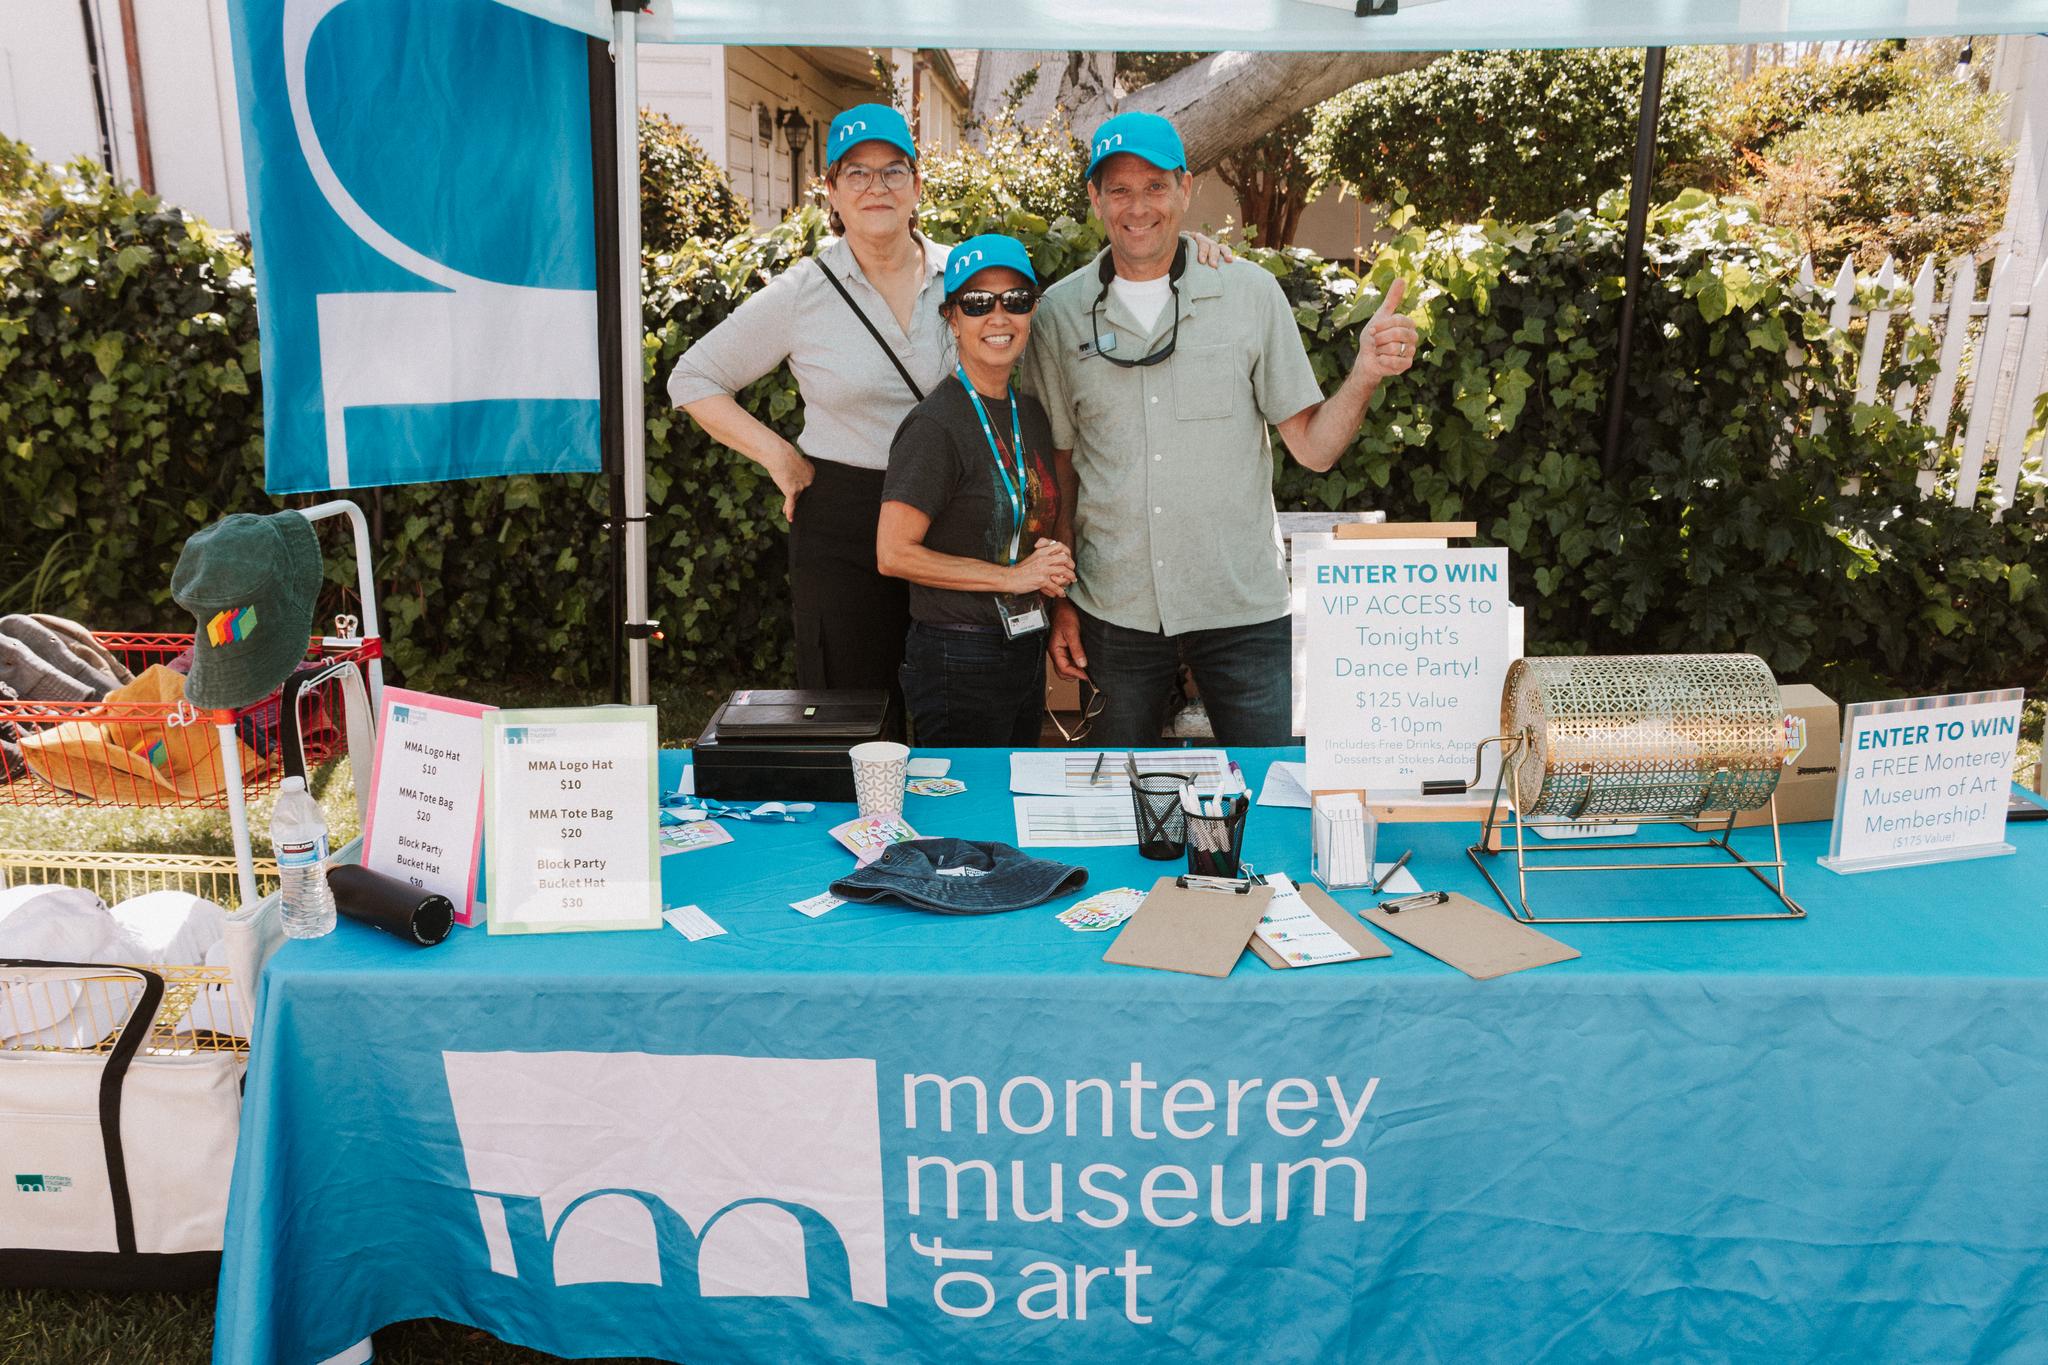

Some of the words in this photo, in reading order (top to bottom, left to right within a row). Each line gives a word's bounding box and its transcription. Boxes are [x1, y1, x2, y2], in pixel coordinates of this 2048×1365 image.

[1317, 564, 1397, 584] ENTER
[1403, 564, 1438, 584] TO
[1445, 563, 1498, 583] WIN
[1322, 595, 1359, 615] VIP
[1366, 595, 1461, 615] ACCESS
[1468, 597, 1492, 614] to
[1355, 625, 1459, 651] Tonight's
[1336, 657, 1408, 677] Dance
[1417, 656, 1478, 678] Party!
[1355, 691, 1401, 709] $125
[1407, 691, 1458, 708] Value
[1371, 716, 1442, 737] 8-10pm
[1858, 725, 1929, 750] ENTER
[1935, 721, 1964, 742] TO
[1971, 715, 2015, 738] WIN
[404, 740, 423, 754] MMA
[424, 743, 444, 761] Logo
[445, 749, 461, 762] Hat
[1325, 739, 1376, 751] (Includes
[1379, 739, 1401, 749] Free
[528, 760, 557, 771] MMA
[560, 759, 589, 773] Logo
[592, 759, 613, 770] Hat
[1334, 754, 1382, 764] Desserts
[1384, 755, 1395, 764] at
[1399, 754, 1434, 764] Stokes
[1854, 766, 1864, 780] a
[1872, 756, 1919, 778] FREE
[1925, 750, 2011, 772] Monterey
[422, 764, 437, 776] $10
[560, 778, 582, 791] $10
[1863, 785, 1941, 807] Museum
[1947, 781, 1966, 797] of
[1970, 776, 1998, 794] Art
[399, 787, 417, 800] MMA
[417, 790, 437, 805] Tote
[438, 796, 454, 811] Bag
[416, 809, 431, 822] $20
[529, 808, 557, 819] MMA
[560, 808, 588, 819] Tote
[591, 807, 613, 821] Bag
[1865, 803, 1987, 834] Membership!
[561, 827, 582, 839] $20
[398, 835, 420, 850] Block
[421, 840, 443, 858] Party
[397, 854, 424, 871] Bucket
[424, 862, 441, 875] Hat
[537, 858, 571, 870] Block
[574, 857, 606, 871] Party
[409, 876, 424, 889] $30
[539, 877, 582, 889] Bucket
[584, 877, 606, 888] Hat
[562, 896, 583, 909] $30
[1271, 892, 1293, 900] NTEER
[903, 1062, 1380, 1148] monterey
[906, 1155, 1367, 1229] museum
[910, 1232, 996, 1318] of
[1016, 1249, 1153, 1324] art
